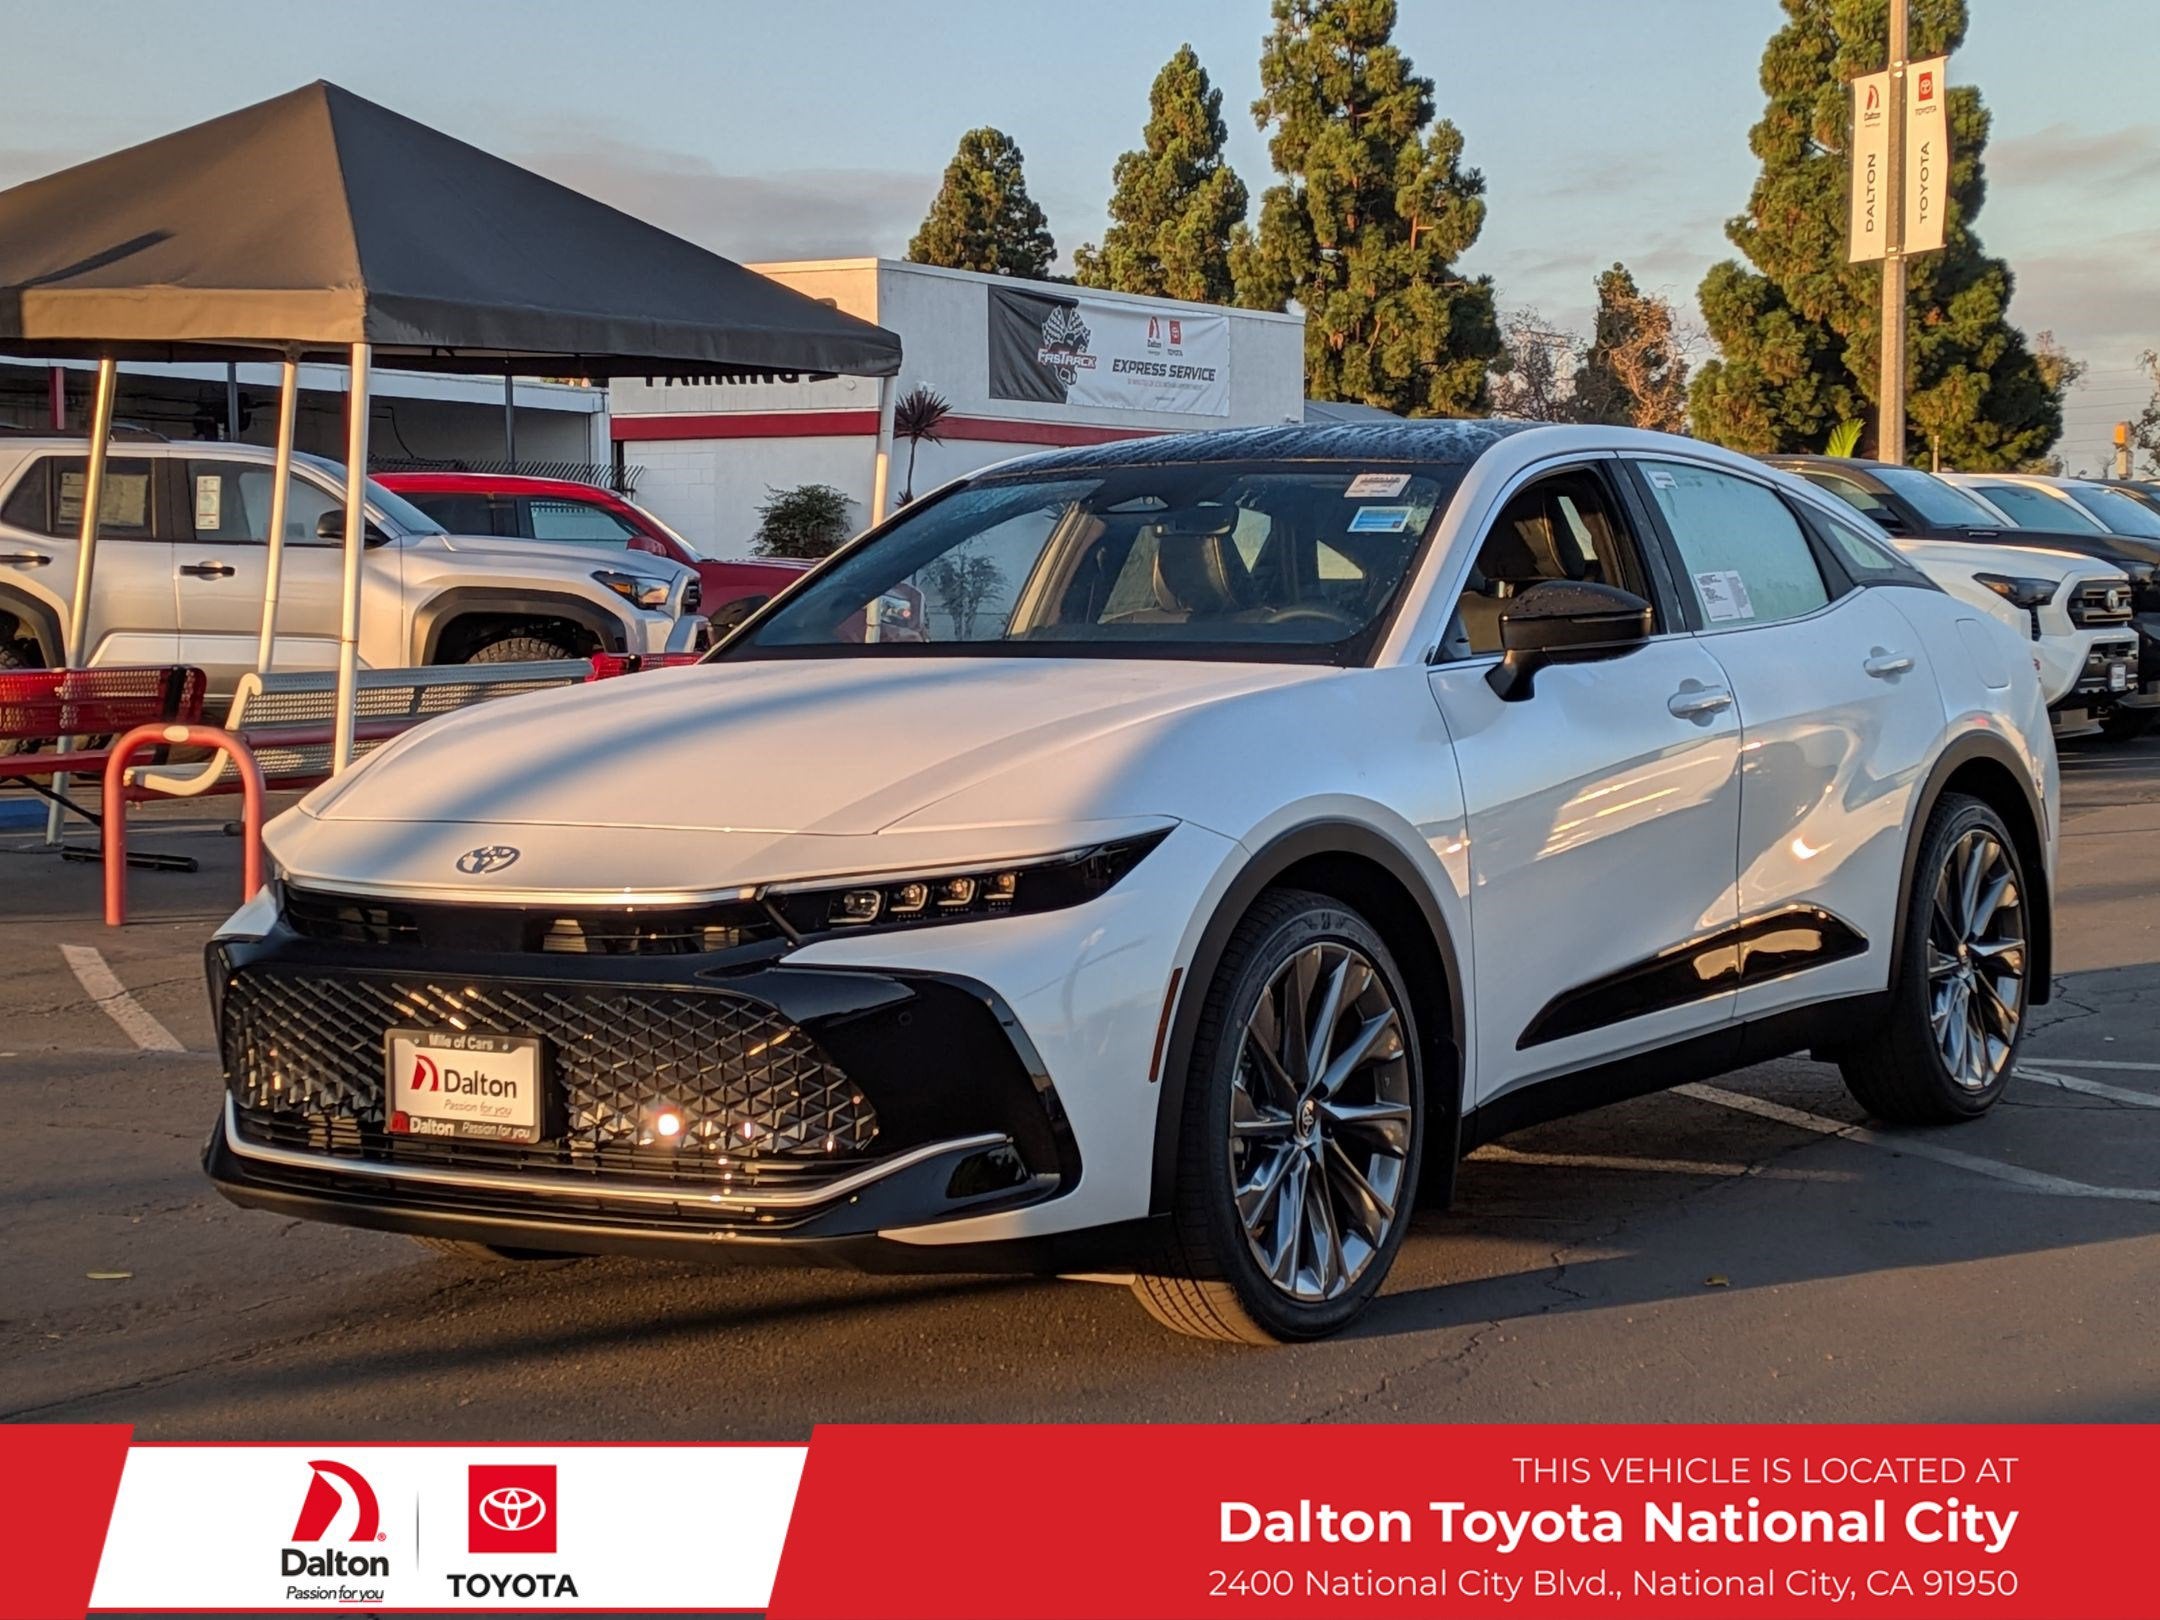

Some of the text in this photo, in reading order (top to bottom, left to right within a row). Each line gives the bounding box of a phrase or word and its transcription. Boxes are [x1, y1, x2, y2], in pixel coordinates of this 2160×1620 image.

[1866, 153, 1876, 232] DALTON
[1920, 141, 1930, 223] TOYOTA
[1112, 358, 1216, 382] EXPRESS SERVICE
[429, 1033, 494, 1051] Mile of Cars
[443, 1069, 517, 1099] Dalton
[443, 1099, 478, 1113] Passion
[494, 1107, 512, 1117] you
[410, 1117, 531, 1139] Dalton Passion for you
